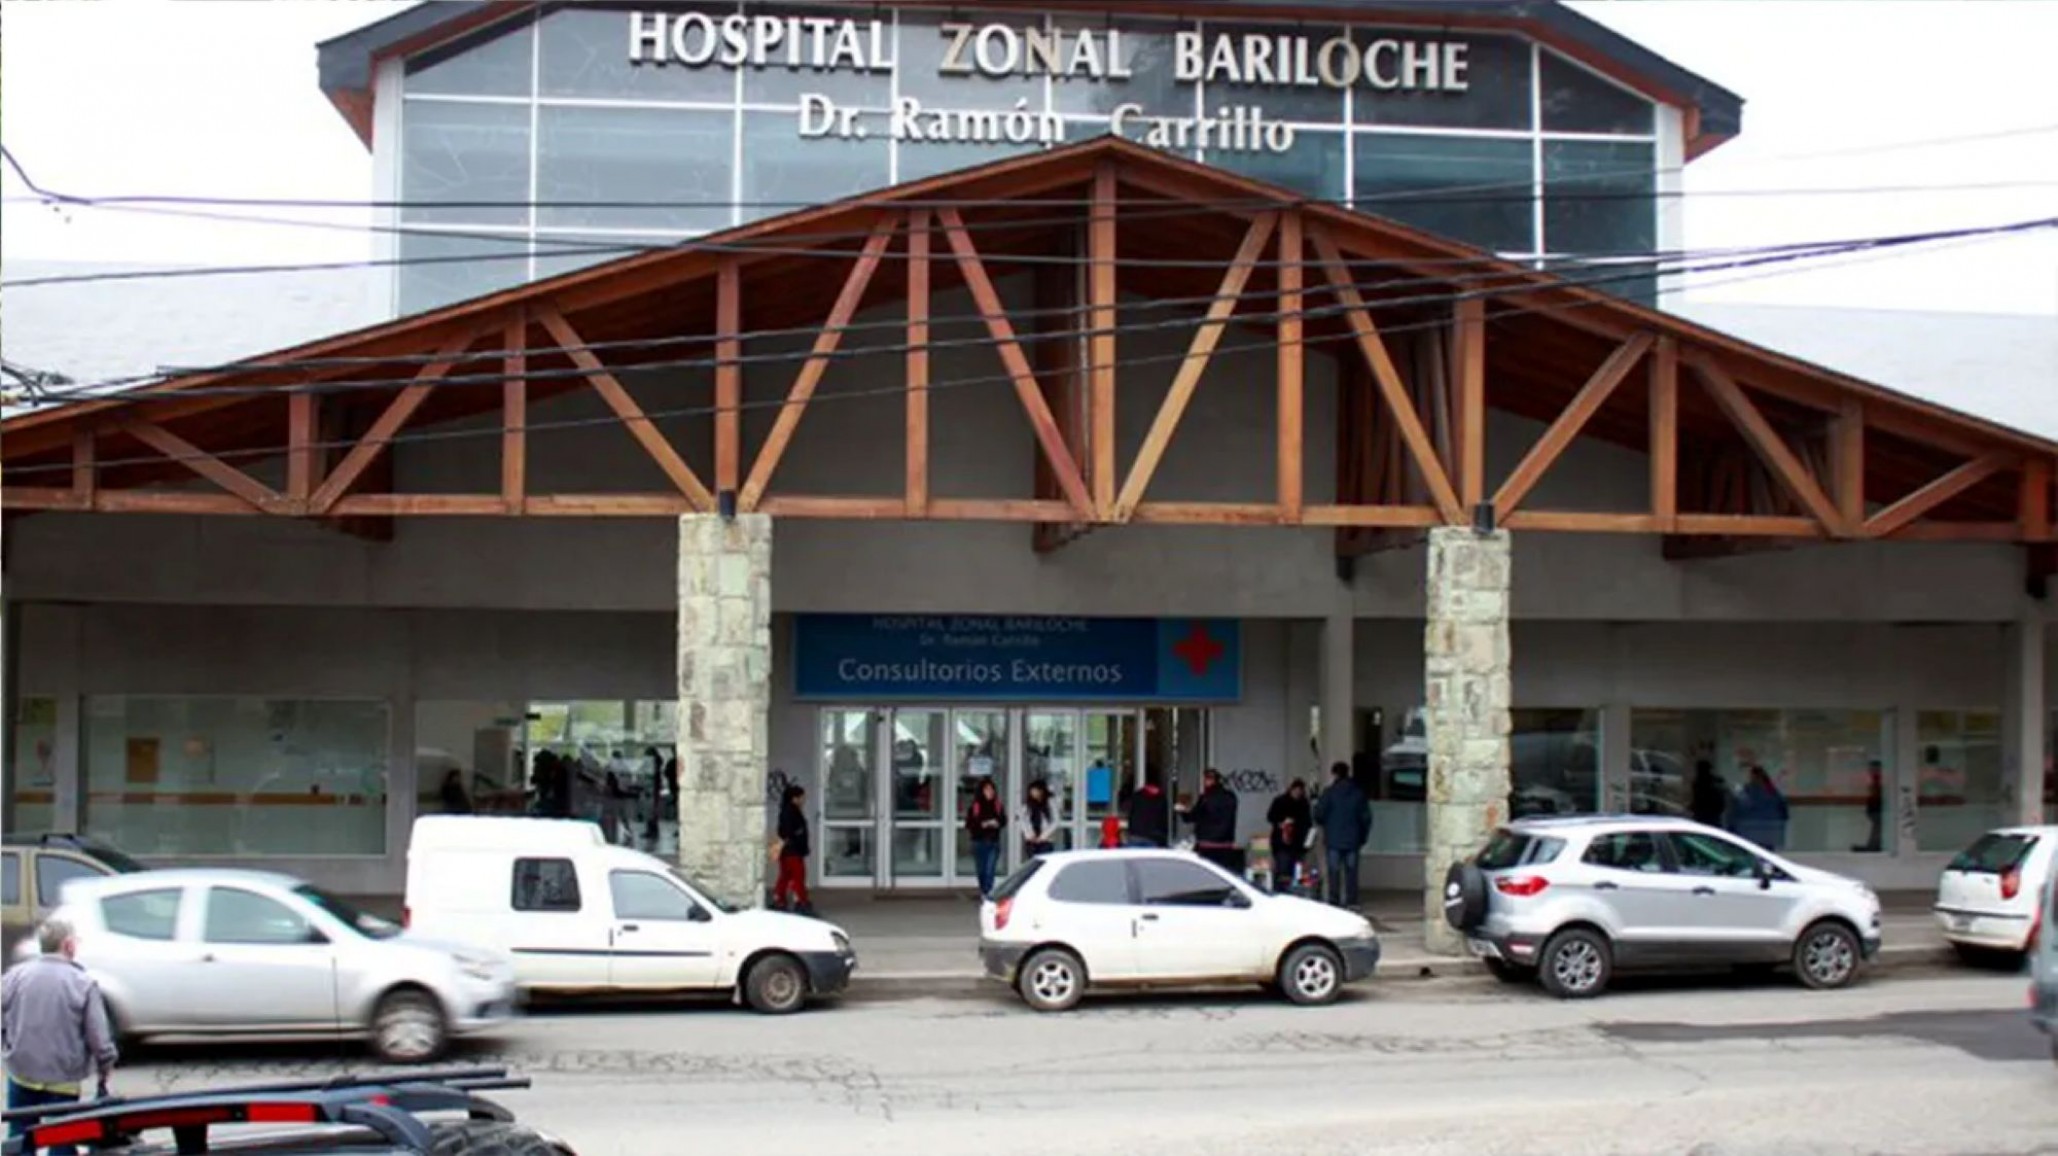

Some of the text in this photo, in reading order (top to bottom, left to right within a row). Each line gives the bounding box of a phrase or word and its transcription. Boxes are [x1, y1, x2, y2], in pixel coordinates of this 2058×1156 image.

[629, 11, 1469, 90] HOSPITAL ZONAL BARILOCHE
[799, 93, 1295, 152] Dr. Ramón Carrillo
[873, 616, 1089, 633] HOSPITAL ZONAL BARILOCHE
[838, 657, 1123, 684] Consultorios Externos
